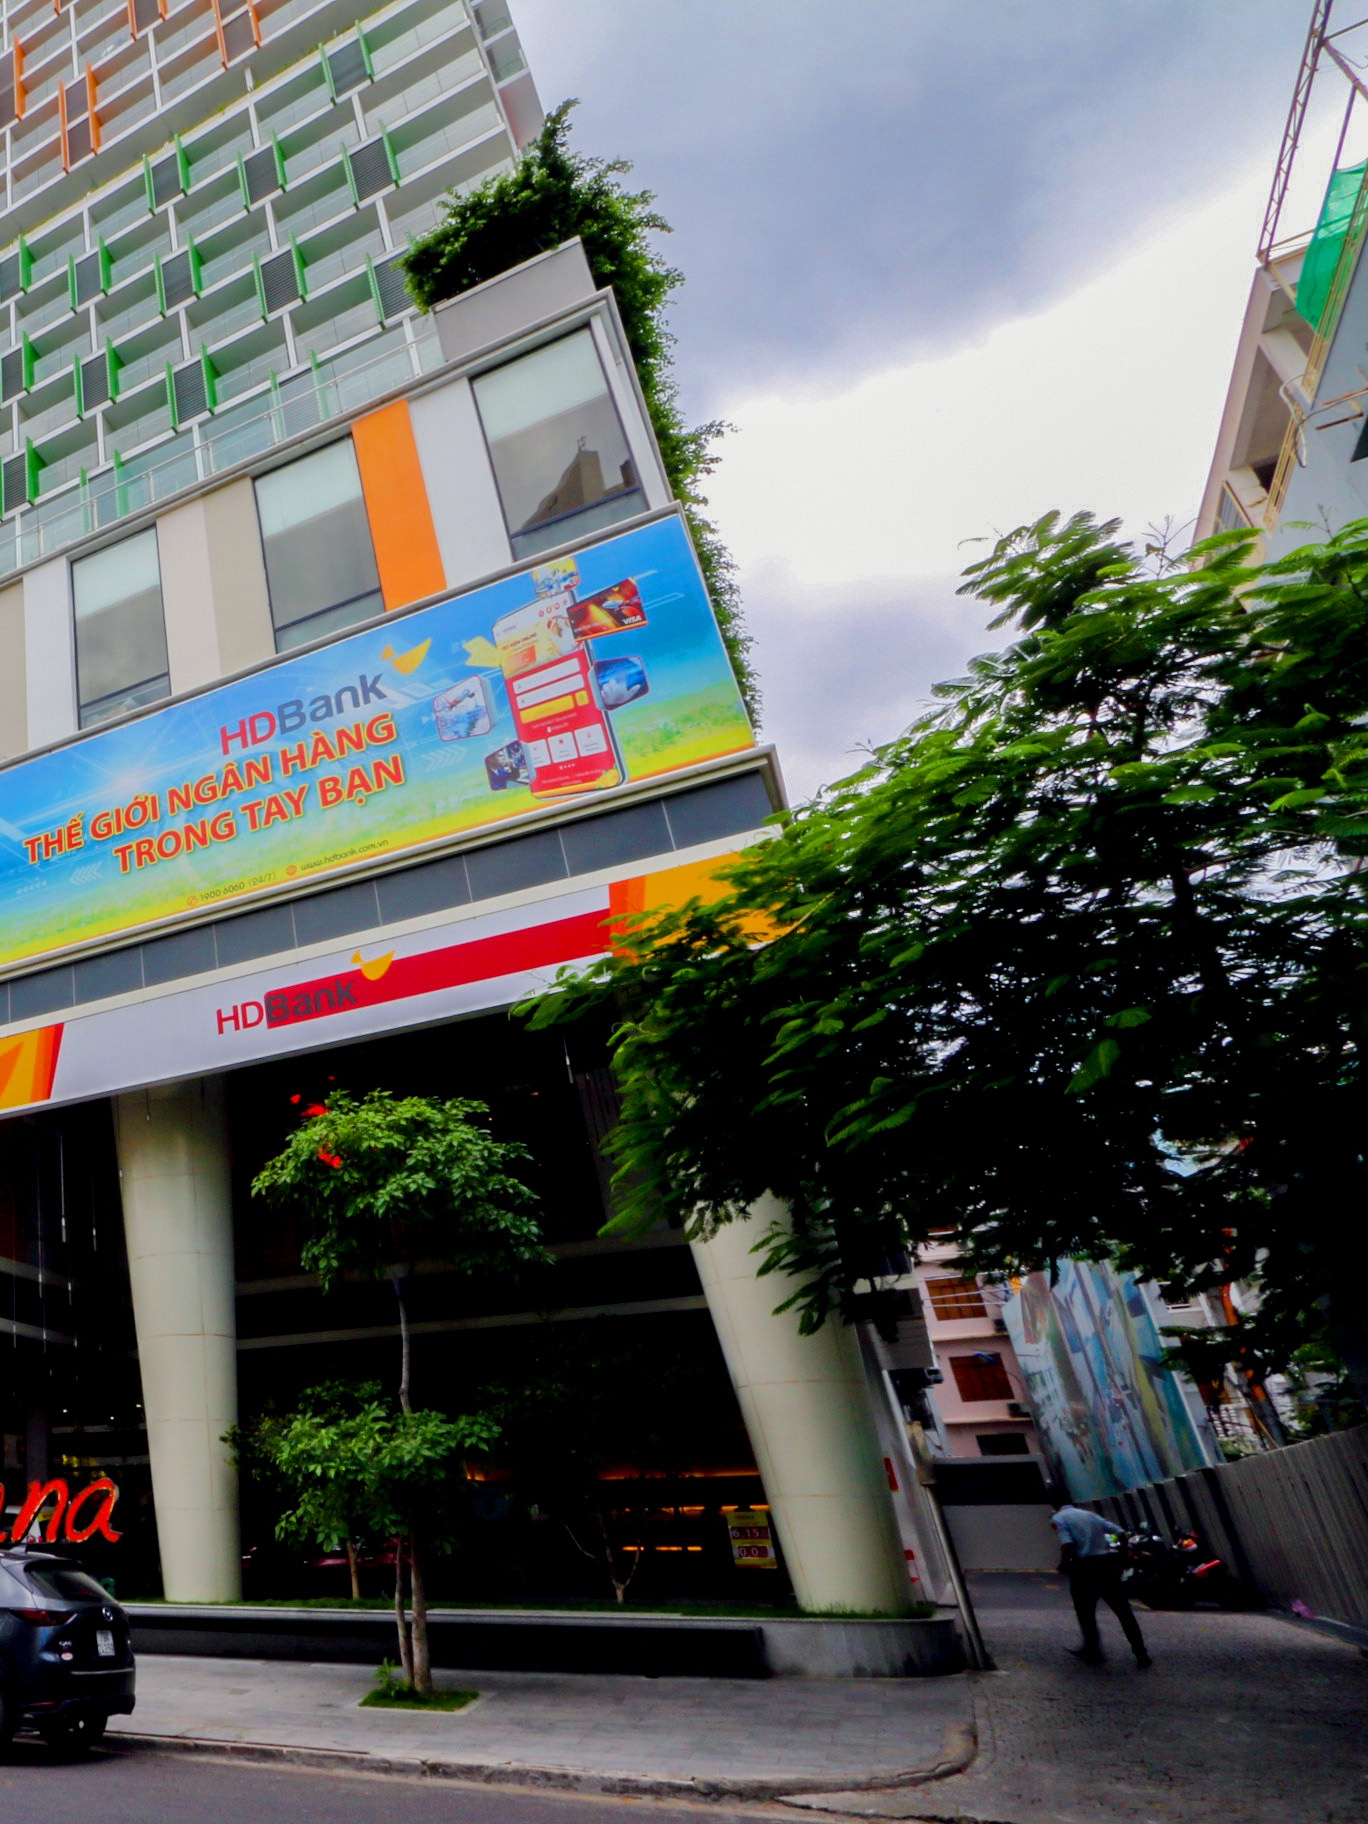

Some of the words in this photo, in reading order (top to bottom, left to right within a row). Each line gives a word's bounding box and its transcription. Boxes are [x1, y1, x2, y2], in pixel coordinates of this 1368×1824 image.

[622, 615, 642, 625] VISA
[220, 673, 388, 756] HDBank
[23, 812, 85, 864] THẾ
[90, 792, 160, 842] GIỚI
[168, 755, 273, 815] NGÂN
[279, 712, 397, 776] HÀNG
[113, 812, 236, 874] TRONG
[241, 785, 309, 832] TAY
[316, 754, 406, 808] BẠN
[200, 887, 221, 902] 1900
[222, 881, 245, 895] 6060
[248, 871, 276, 888] (24/7)
[301, 839, 389, 871] www.hdbank.com.vn
[216, 979, 358, 1035] HDBank
